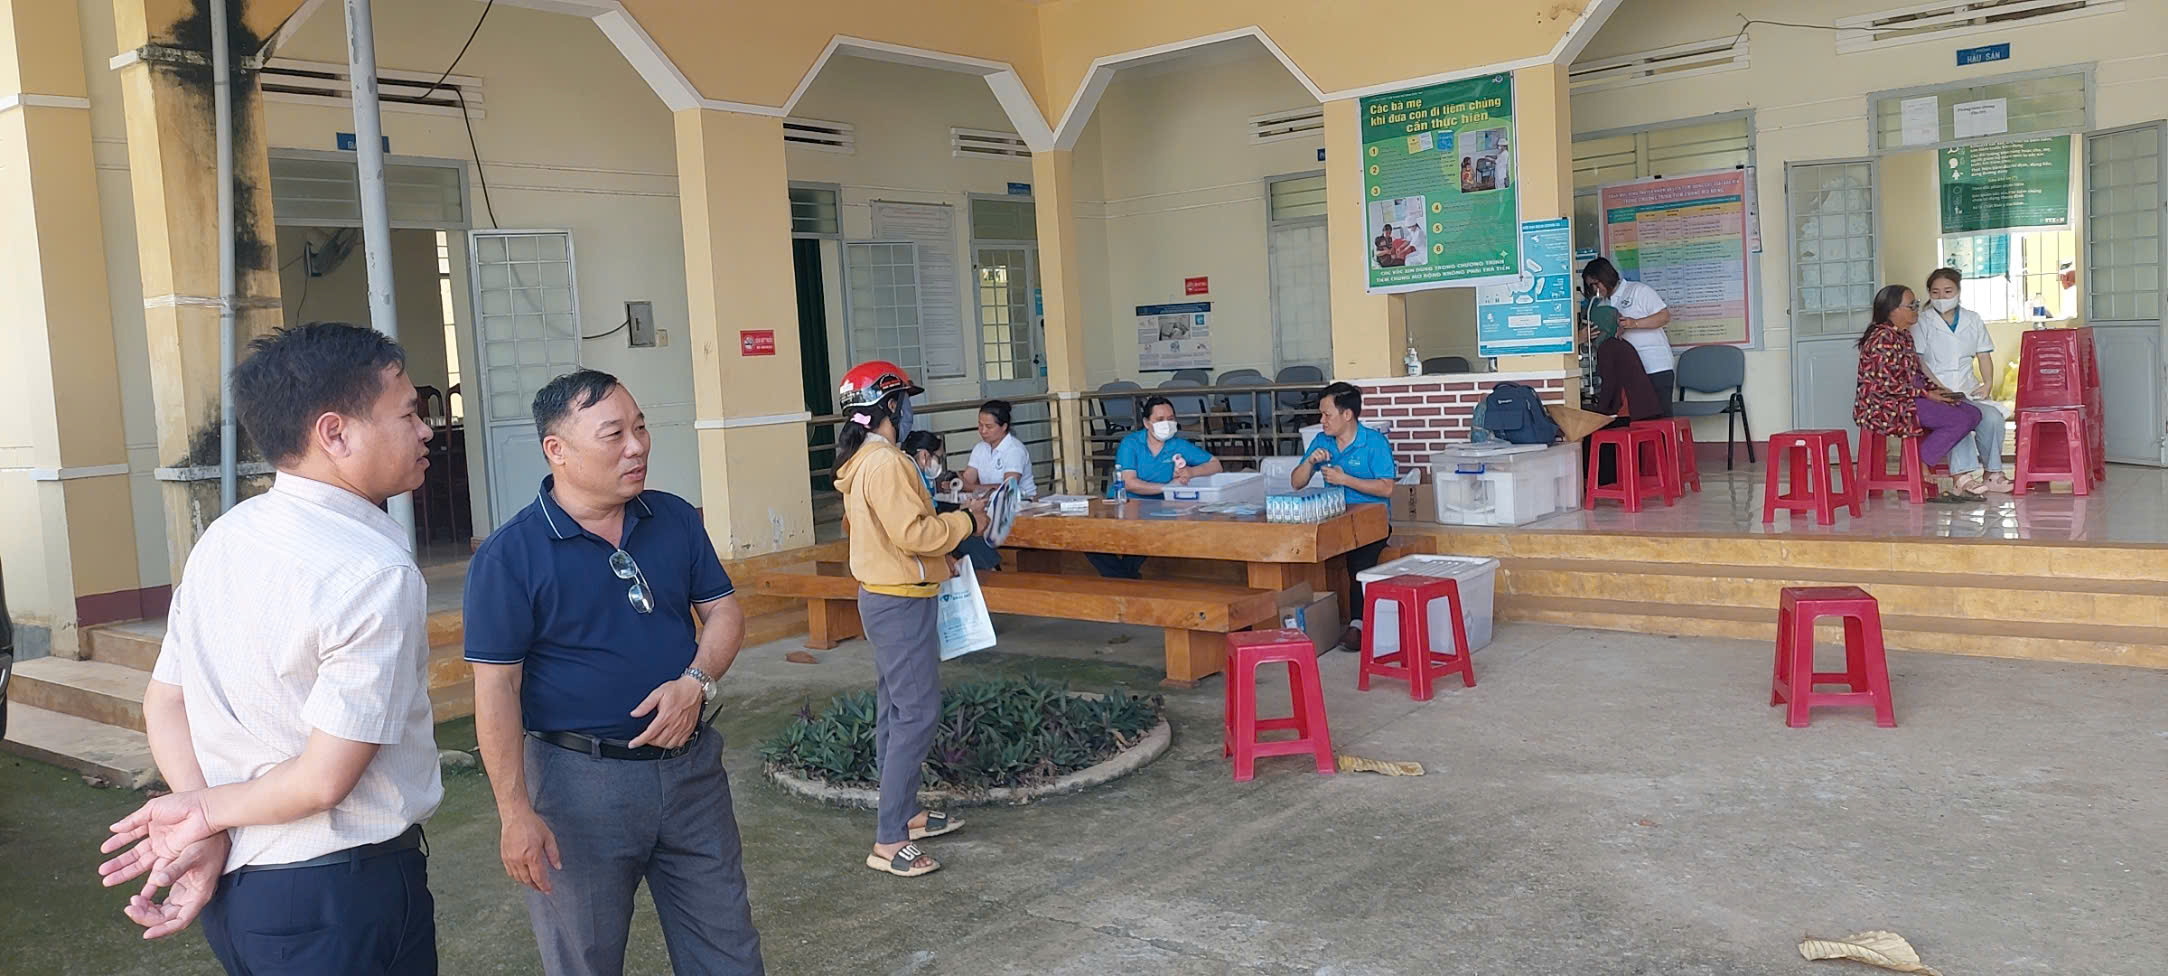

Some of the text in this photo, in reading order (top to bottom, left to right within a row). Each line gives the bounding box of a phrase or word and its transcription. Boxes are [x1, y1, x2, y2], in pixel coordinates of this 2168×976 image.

[1370, 102, 1388, 115] Các
[1406, 98, 1422, 109] mẹ
[1370, 115, 1386, 127] khi
[1388, 112, 1407, 124] đưa
[1430, 107, 1440, 117] đi
[1442, 102, 1466, 115] tiêm
[1431, 115, 1458, 129] thực
[1461, 111, 1489, 124] hiện
